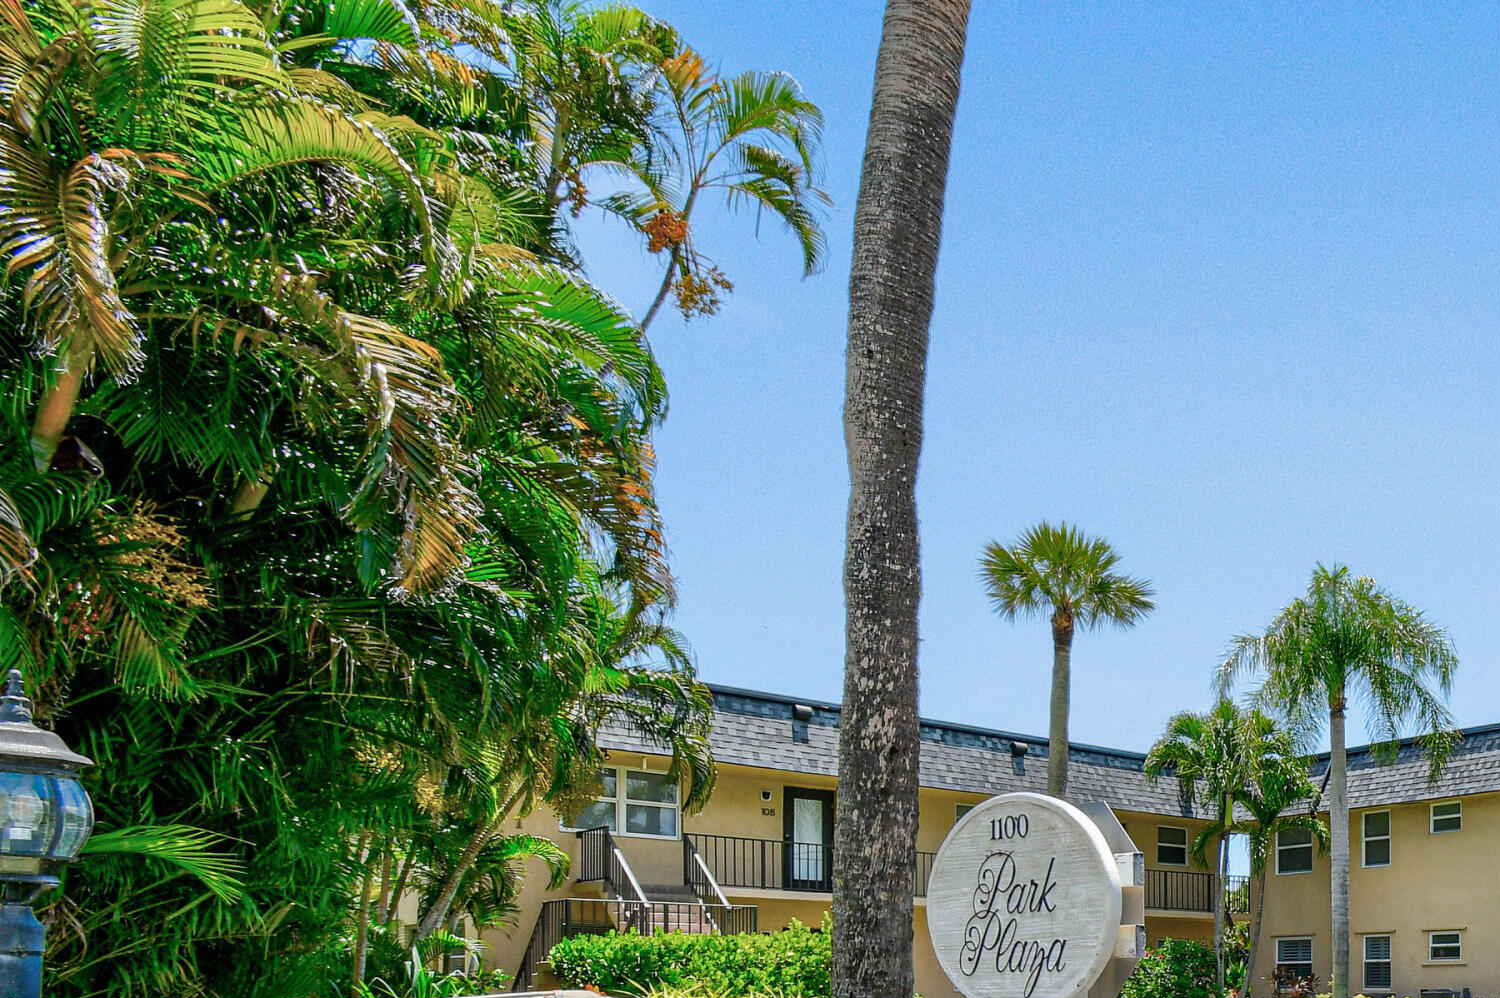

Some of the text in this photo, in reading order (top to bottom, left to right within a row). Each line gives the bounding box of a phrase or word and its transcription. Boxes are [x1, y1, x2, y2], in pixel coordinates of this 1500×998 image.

[990, 814, 1029, 841] 1100
[973, 850, 1057, 919] Park
[960, 909, 1067, 998] Plaza
